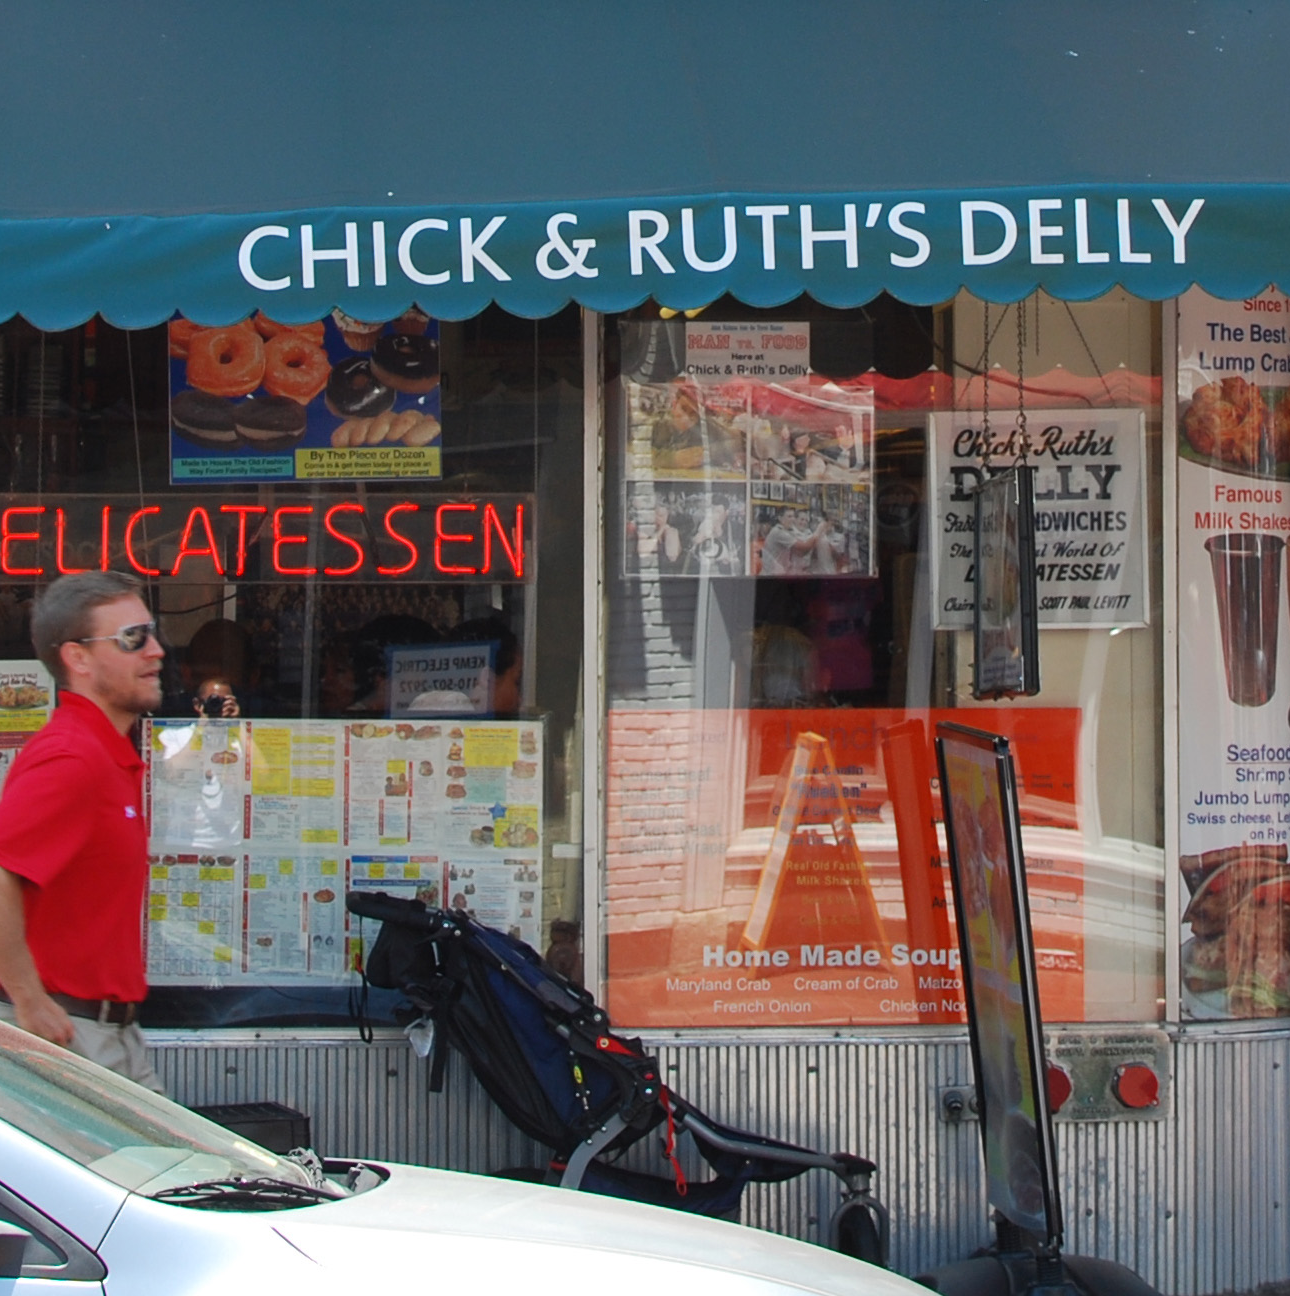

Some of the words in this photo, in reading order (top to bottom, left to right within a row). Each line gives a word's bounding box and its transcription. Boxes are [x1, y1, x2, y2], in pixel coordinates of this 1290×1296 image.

[239, 216, 510, 291] CHICK
[534, 214, 598, 280] &
[628, 200, 932, 277] RUTH'S
[960, 199, 1205, 269] DELLY
[1244, 297, 1281, 312] Since
[1206, 323, 1244, 341] The
[1250, 324, 1286, 343] Best
[688, 334, 730, 349] MAN
[761, 334, 807, 349] FOOD
[1199, 352, 1255, 373] Lump
[687, 365, 720, 375] Chick
[724, 365, 732, 375] &
[779, 365, 808, 376] Delly
[310, 451, 324, 461] By
[327, 451, 346, 460] The
[349, 450, 377, 460] Piece
[393, 450, 425, 459] Dozen
[1215, 485, 1282, 503] Famous
[1195, 512, 1233, 529] Milk
[1053, 542, 1095, 557] World
[1194, 791, 1249, 806] Jumbo
[1254, 791, 1290, 807] Lump
[1187, 813, 1226, 824] Swiss
[1250, 829, 1264, 840] on
[1267, 828, 1287, 841] Rye
[703, 945, 789, 967] Home
[800, 944, 880, 966] Made
[666, 977, 731, 995] Maryland
[736, 977, 770, 991] Crab
[794, 977, 838, 991] Cream
[846, 977, 860, 991] of
[864, 977, 898, 991] Crab
[919, 977, 962, 991] Matzo
[714, 1000, 766, 1014] French
[770, 1000, 811, 1014] Onion
[880, 999, 936, 1013] Chicken
